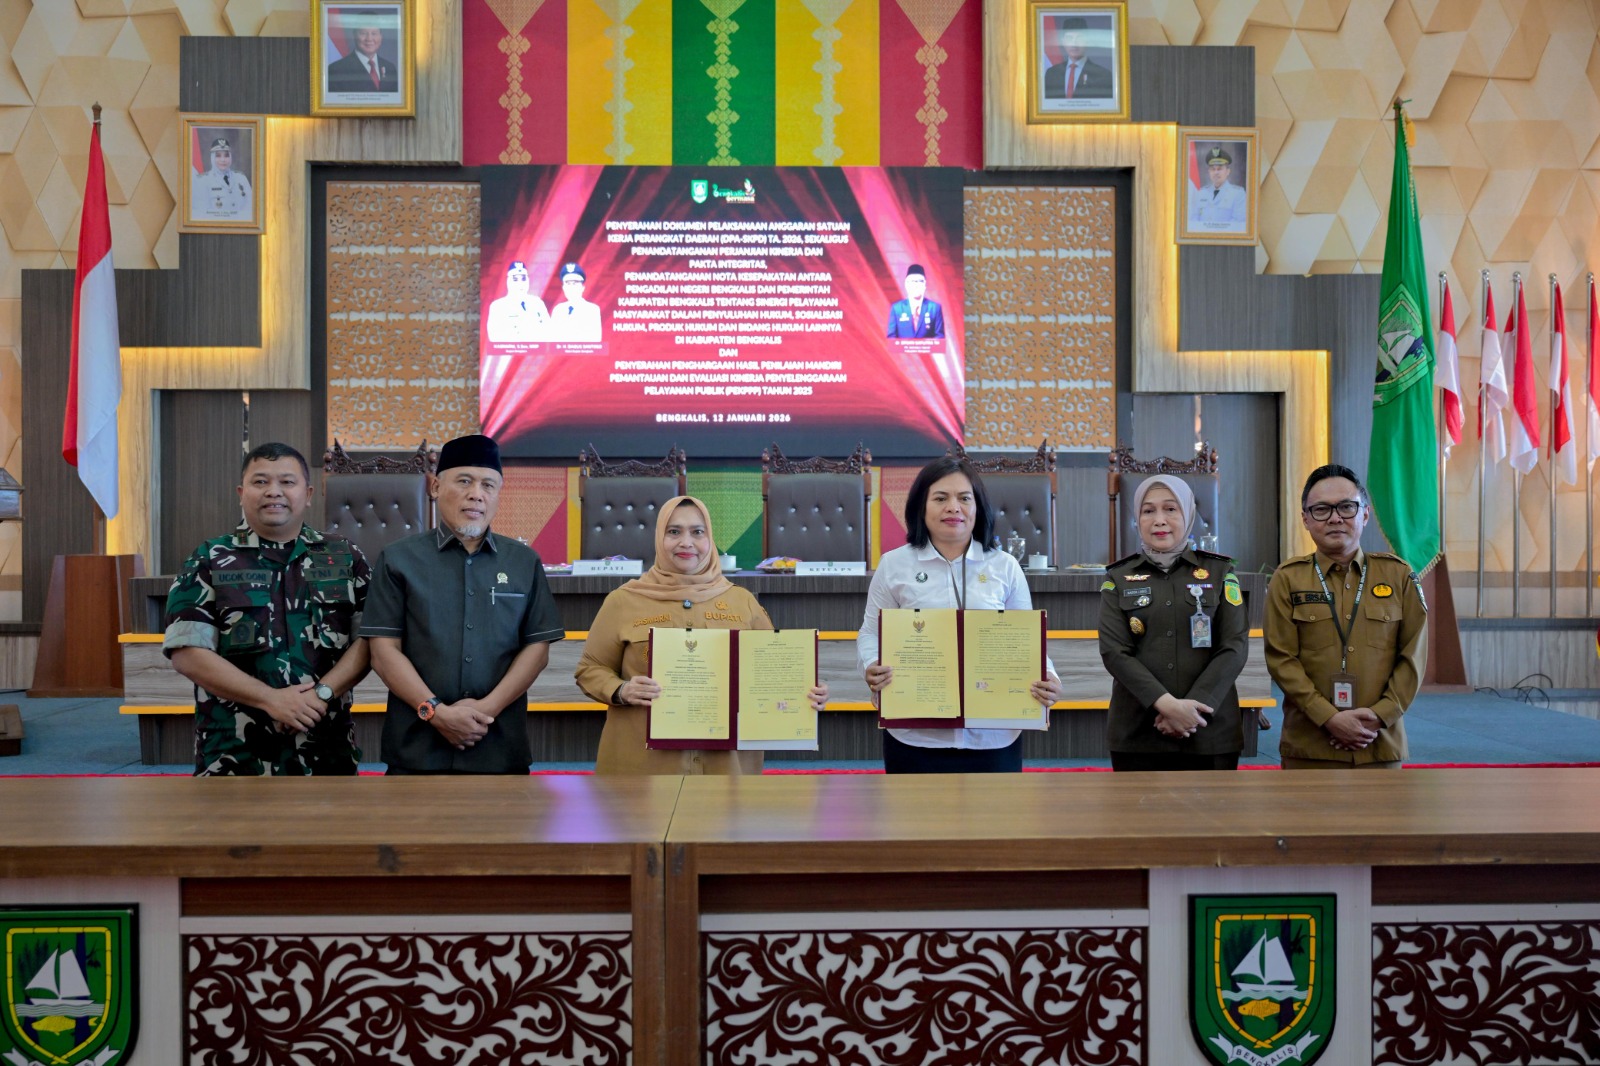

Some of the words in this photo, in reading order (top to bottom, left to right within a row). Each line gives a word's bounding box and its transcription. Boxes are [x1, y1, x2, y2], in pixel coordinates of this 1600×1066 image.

[606, 222, 661, 230] PENYERAHAN
[663, 222, 706, 230] DOKUMEN
[708, 222, 767, 230] PELAKSANAAN
[768, 222, 815, 230] ANGGARAN
[817, 222, 850, 230] SATUAN
[608, 234, 633, 243] KERJA
[634, 234, 684, 243] PERANGKAT
[685, 234, 719, 243] DAERAH
[768, 234, 781, 243] TA.
[805, 234, 849, 243] SEKALIGUS
[631, 247, 718, 255] PENANDATANGANAN
[719, 247, 768, 255] PERJANJIAN
[769, 247, 803, 255] KINERJA
[805, 247, 823, 255] DAN
[689, 260, 717, 268] PAKTA
[625, 272, 711, 280] PENANDATANGANAN
[713, 272, 737, 280] NOTA
[738, 272, 796, 280] KESEPAKATAN
[798, 272, 832, 280] ANTARA
[626, 285, 679, 293] PENGADILAN
[680, 285, 709, 293] NEGERI
[711, 285, 756, 293] BENGKALIS
[757, 285, 776, 293] DAN
[777, 285, 830, 293] PEMERINTAH
[618, 298, 668, 306] KABUPATEN
[669, 298, 714, 306] BENGKALIS
[716, 298, 754, 306] TENTANG
[756, 298, 787, 306] SINERGI
[789, 298, 838, 306] PELAYANAN
[613, 310, 670, 319] MASYARAKAT
[671, 310, 701, 319] DALAM
[703, 310, 758, 319] PENYULUHAN
[760, 310, 794, 320] HUKUM,
[613, 323, 647, 332] HUKUM,
[649, 323, 684, 331] PRODUK
[685, 323, 717, 331] HUKUM
[718, 323, 737, 331] DAN
[738, 323, 771, 331] BIDANG
[772, 323, 804, 331] HUKUM
[805, 323, 841, 331] LAINNYA
[675, 336, 684, 344] DI
[686, 336, 735, 344] KABUPATEN
[737, 336, 782, 344] BENGKALIS
[719, 348, 738, 357] DAN
[615, 361, 670, 369] PENYERAHAN
[672, 361, 735, 369] PENGHARGAAN
[736, 361, 759, 369] HASIL
[610, 374, 668, 382] PEMANTAUAN
[670, 374, 688, 382] DAN
[689, 374, 729, 382] EVALUASI
[730, 374, 764, 382] KINERJA
[766, 374, 847, 382] PENYELENGGARAAN
[644, 386, 694, 395] PELAYANAN
[695, 386, 724, 395] PUBLIK
[762, 386, 792, 395] TAHUN
[793, 386, 813, 395] 2025
[713, 414, 723, 422] 12
[727, 414, 766, 422] JANUARI
[769, 414, 791, 422] 2026
[310, 569, 331, 578] TNI
[1305, 594, 1328, 602] ERSA
[632, 613, 672, 627] KASMARNI
[704, 611, 743, 622] BUPATI
[1236, 1047, 1294, 1066] BENGKALIS
